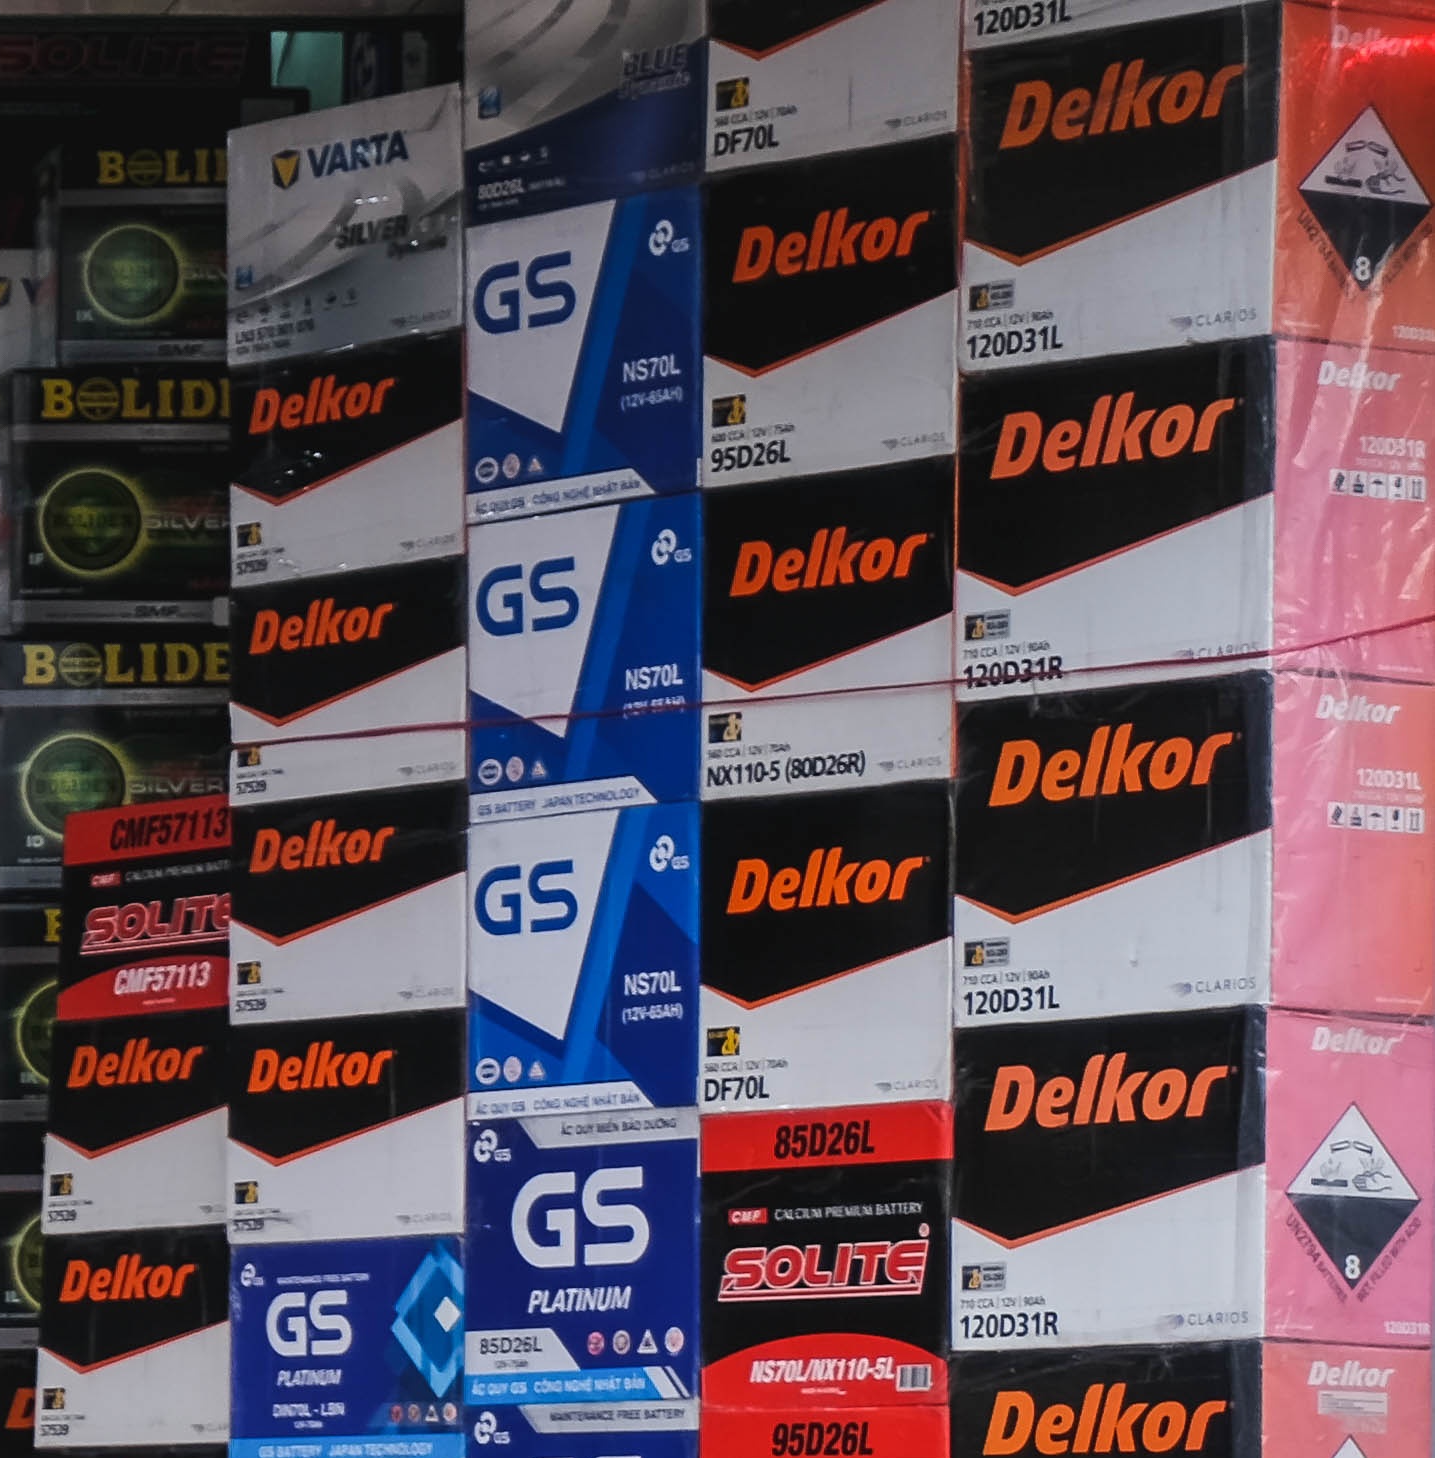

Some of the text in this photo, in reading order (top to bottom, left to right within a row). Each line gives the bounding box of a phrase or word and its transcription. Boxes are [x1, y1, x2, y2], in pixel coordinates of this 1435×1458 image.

[999, 59, 1244, 149] Delkor
[307, 130, 409, 177] VARTA
[713, 127, 779, 156] DF70L
[1196, 308, 1257, 328] CLARIOS
[967, 327, 1063, 361] 120D31L
[622, 355, 680, 381] NS70L
[706, 752, 866, 787] NX110-5 (80D26R)
[114, 962, 211, 994] CMF57113
[624, 971, 682, 995] NS70L
[67, 1038, 202, 1088] Delkor
[984, 1052, 1229, 1132] Delkor
[774, 1121, 875, 1158] 85D26L
[1344, 1255, 1360, 1280] 8
[960, 1313, 1059, 1339] 120D31R
[1188, 1311, 1249, 1327] CLARIOS
[772, 1422, 873, 1457] 95D26L
